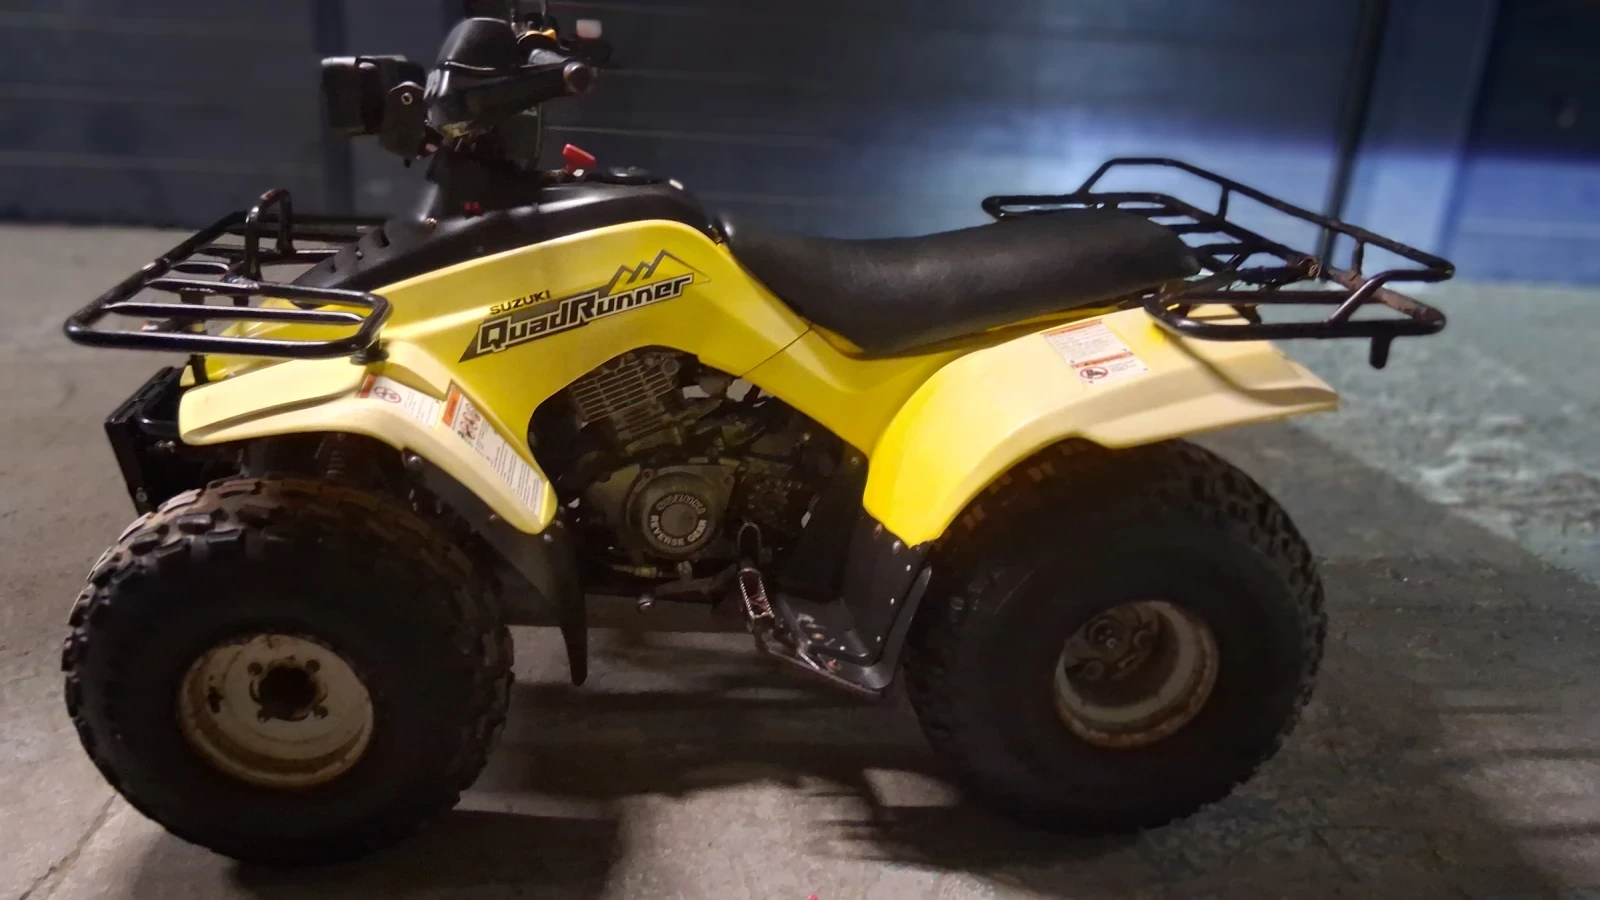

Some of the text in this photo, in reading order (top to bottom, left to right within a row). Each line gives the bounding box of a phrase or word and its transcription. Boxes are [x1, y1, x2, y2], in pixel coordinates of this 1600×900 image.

[477, 273, 694, 354] QuadRunner
[490, 290, 551, 315] SUZUKI
[650, 515, 685, 546] REVERSE
